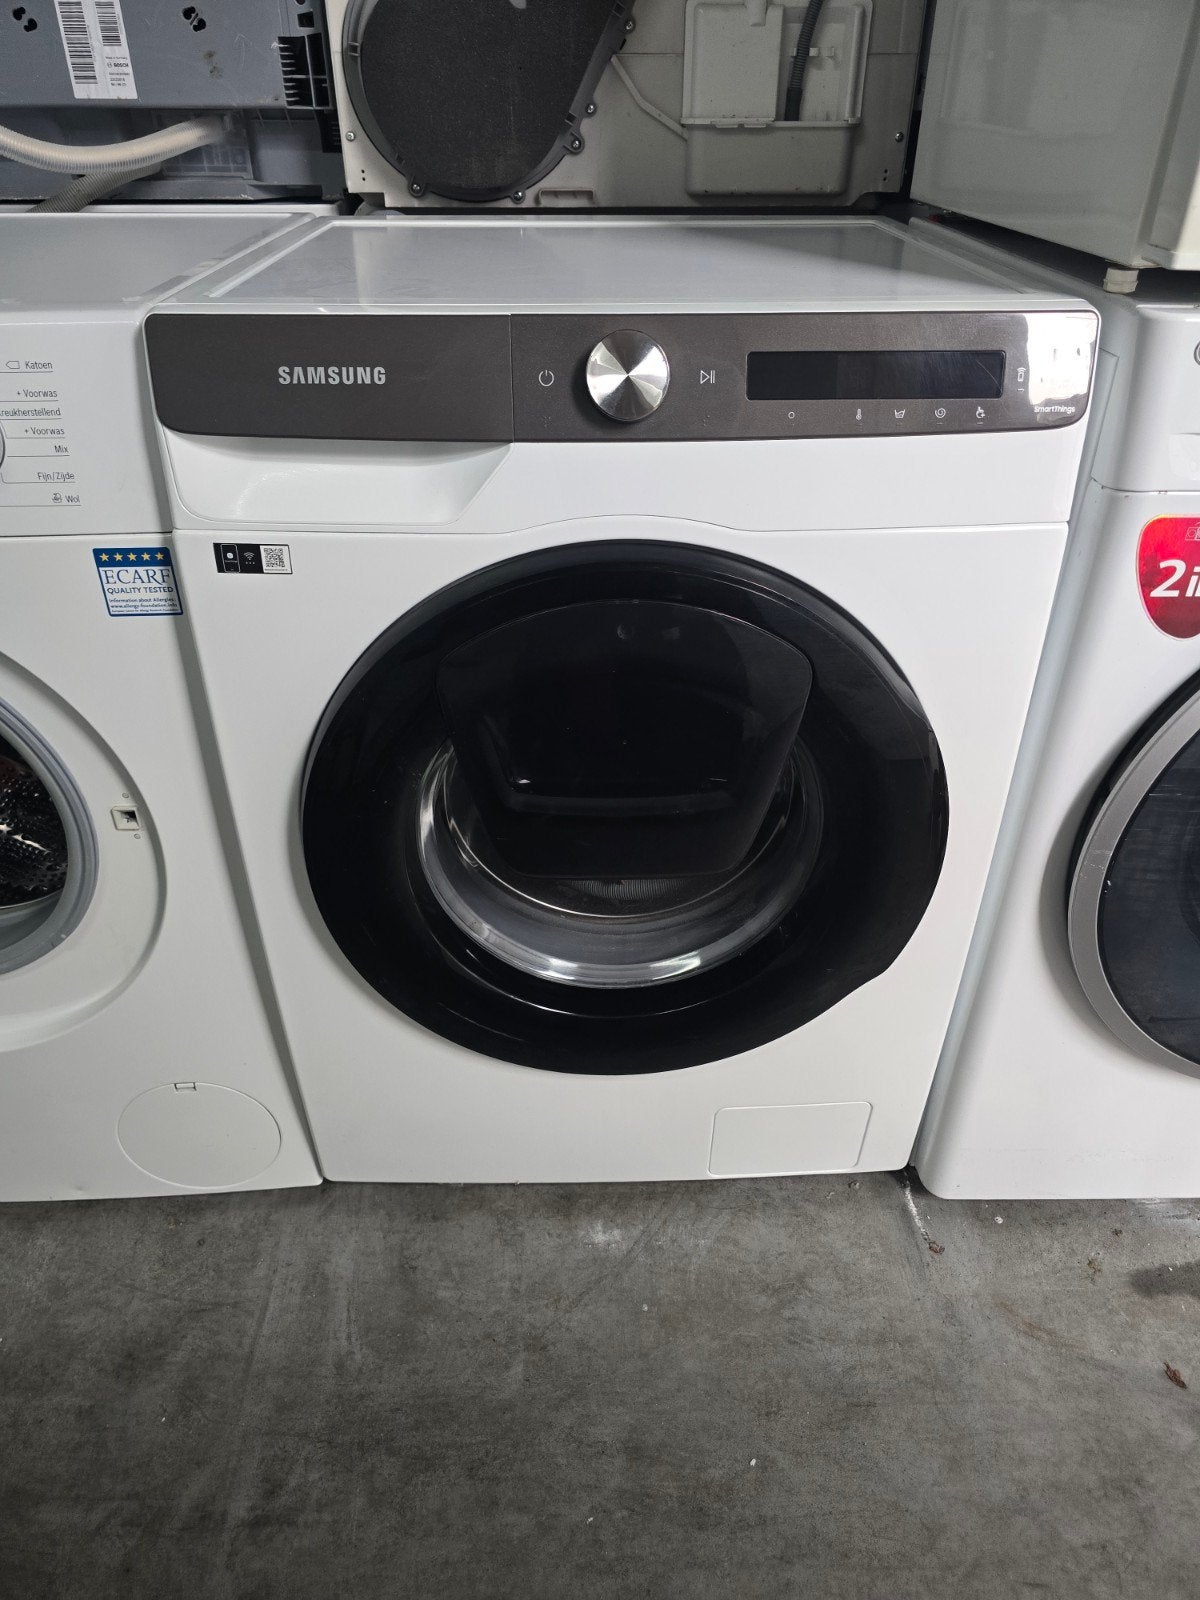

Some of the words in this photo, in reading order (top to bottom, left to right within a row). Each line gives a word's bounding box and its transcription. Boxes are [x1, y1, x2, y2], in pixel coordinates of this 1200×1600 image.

[25, 360, 53, 370] Katoen
[278, 366, 386, 385] SAMSUNG
[23, 389, 58, 398] Voorwas
[0, 407, 61, 417] reukherstellend
[1034, 405, 1075, 414] SmartThings
[30, 427, 65, 435] Voorwas
[54, 445, 69, 453] Mix
[65, 495, 80, 503] Wol
[102, 569, 170, 585] ECARF
[1149, 559, 1186, 598] 2
[107, 587, 141, 595] QUALITY
